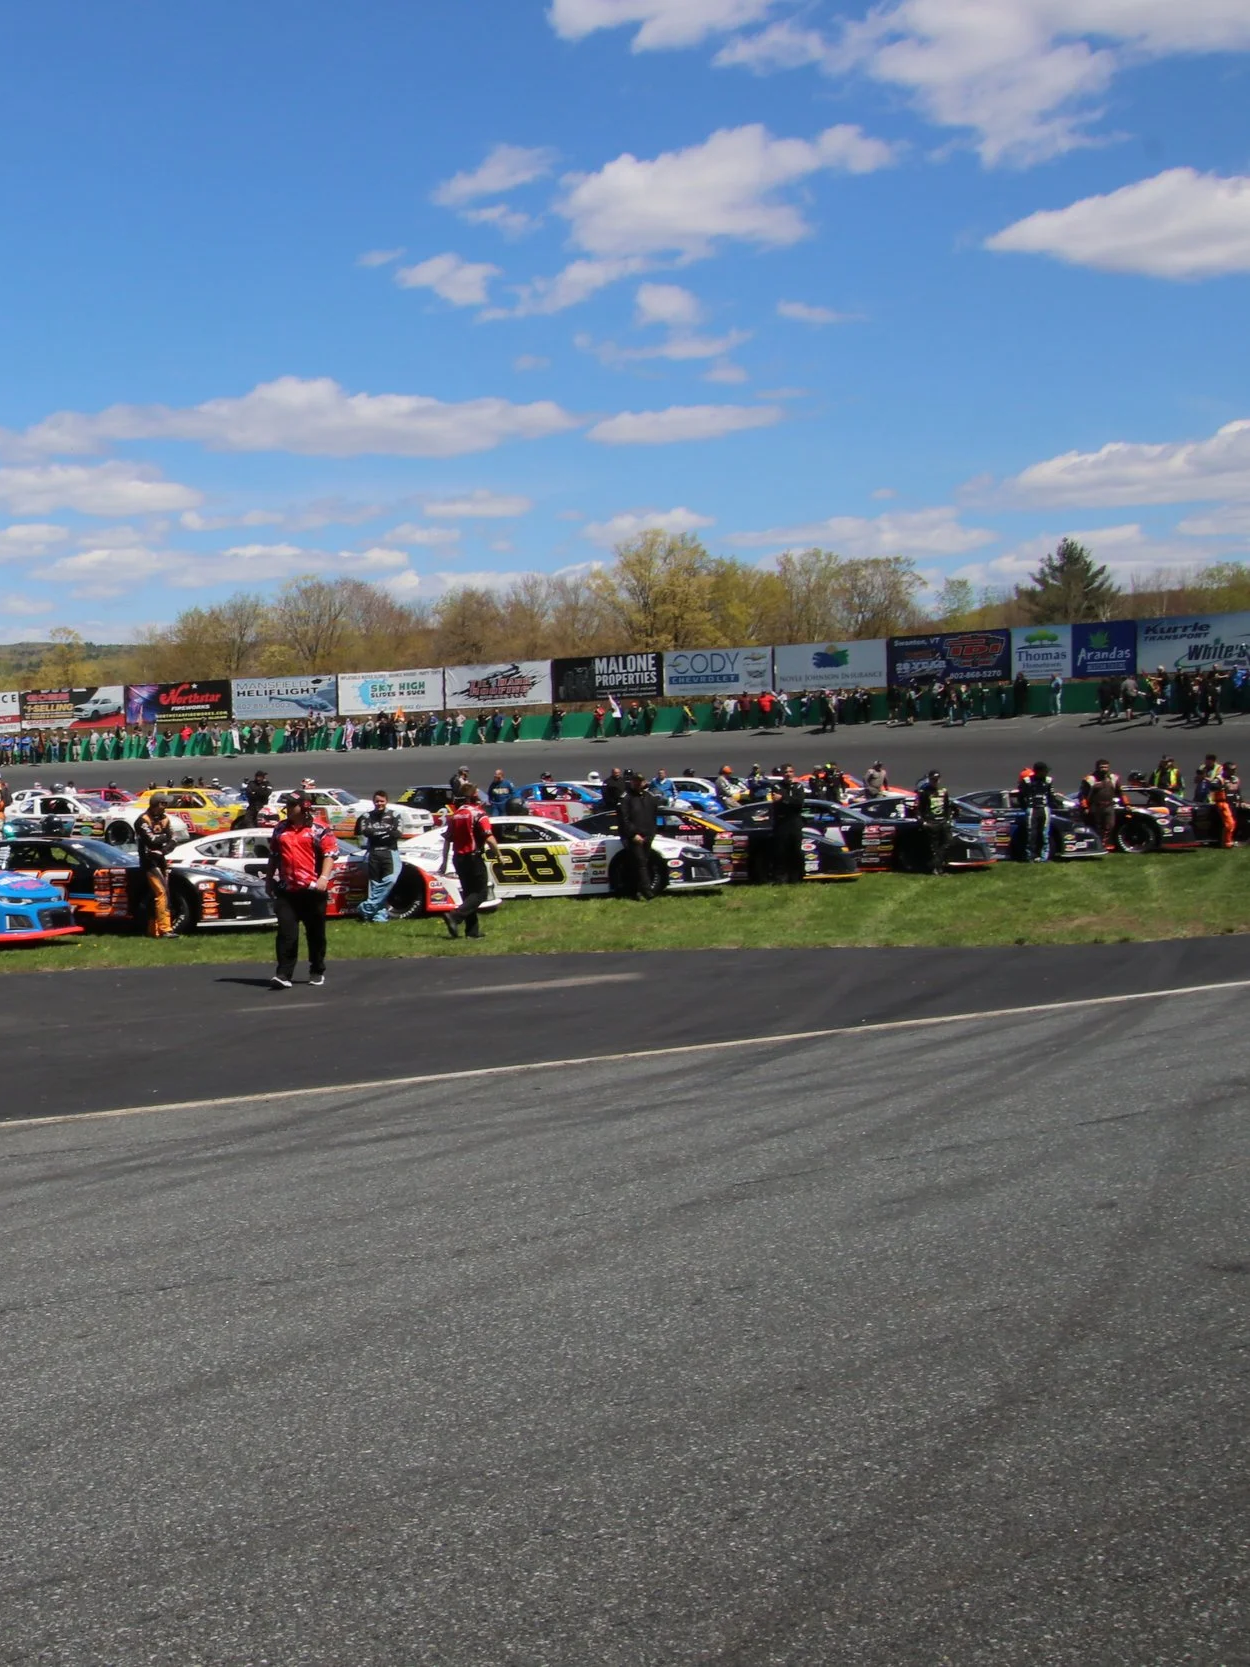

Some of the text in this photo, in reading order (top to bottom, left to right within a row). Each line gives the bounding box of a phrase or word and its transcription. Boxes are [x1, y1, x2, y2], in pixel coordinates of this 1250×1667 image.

[1144, 632, 1210, 641] TRANSPORT
[1017, 651, 1067, 661] Thomas
[1077, 647, 1131, 666] Arandas
[595, 654, 657, 674] MALONE
[673, 652, 739, 674] CODY
[595, 671, 657, 687] PROPERTIES
[672, 675, 735, 684] CHEVROLET
[805, 673, 839, 681] JOHNSON
[841, 671, 882, 679] INSURANCE
[236, 680, 309, 690] MANSFIELD
[371, 681, 425, 692] SKY HIGH
[159, 681, 222, 705] Northstar
[237, 687, 318, 697] HELIFLIGHT
[171, 704, 210, 712] FIREWORKS
[482, 845, 568, 885] 28
